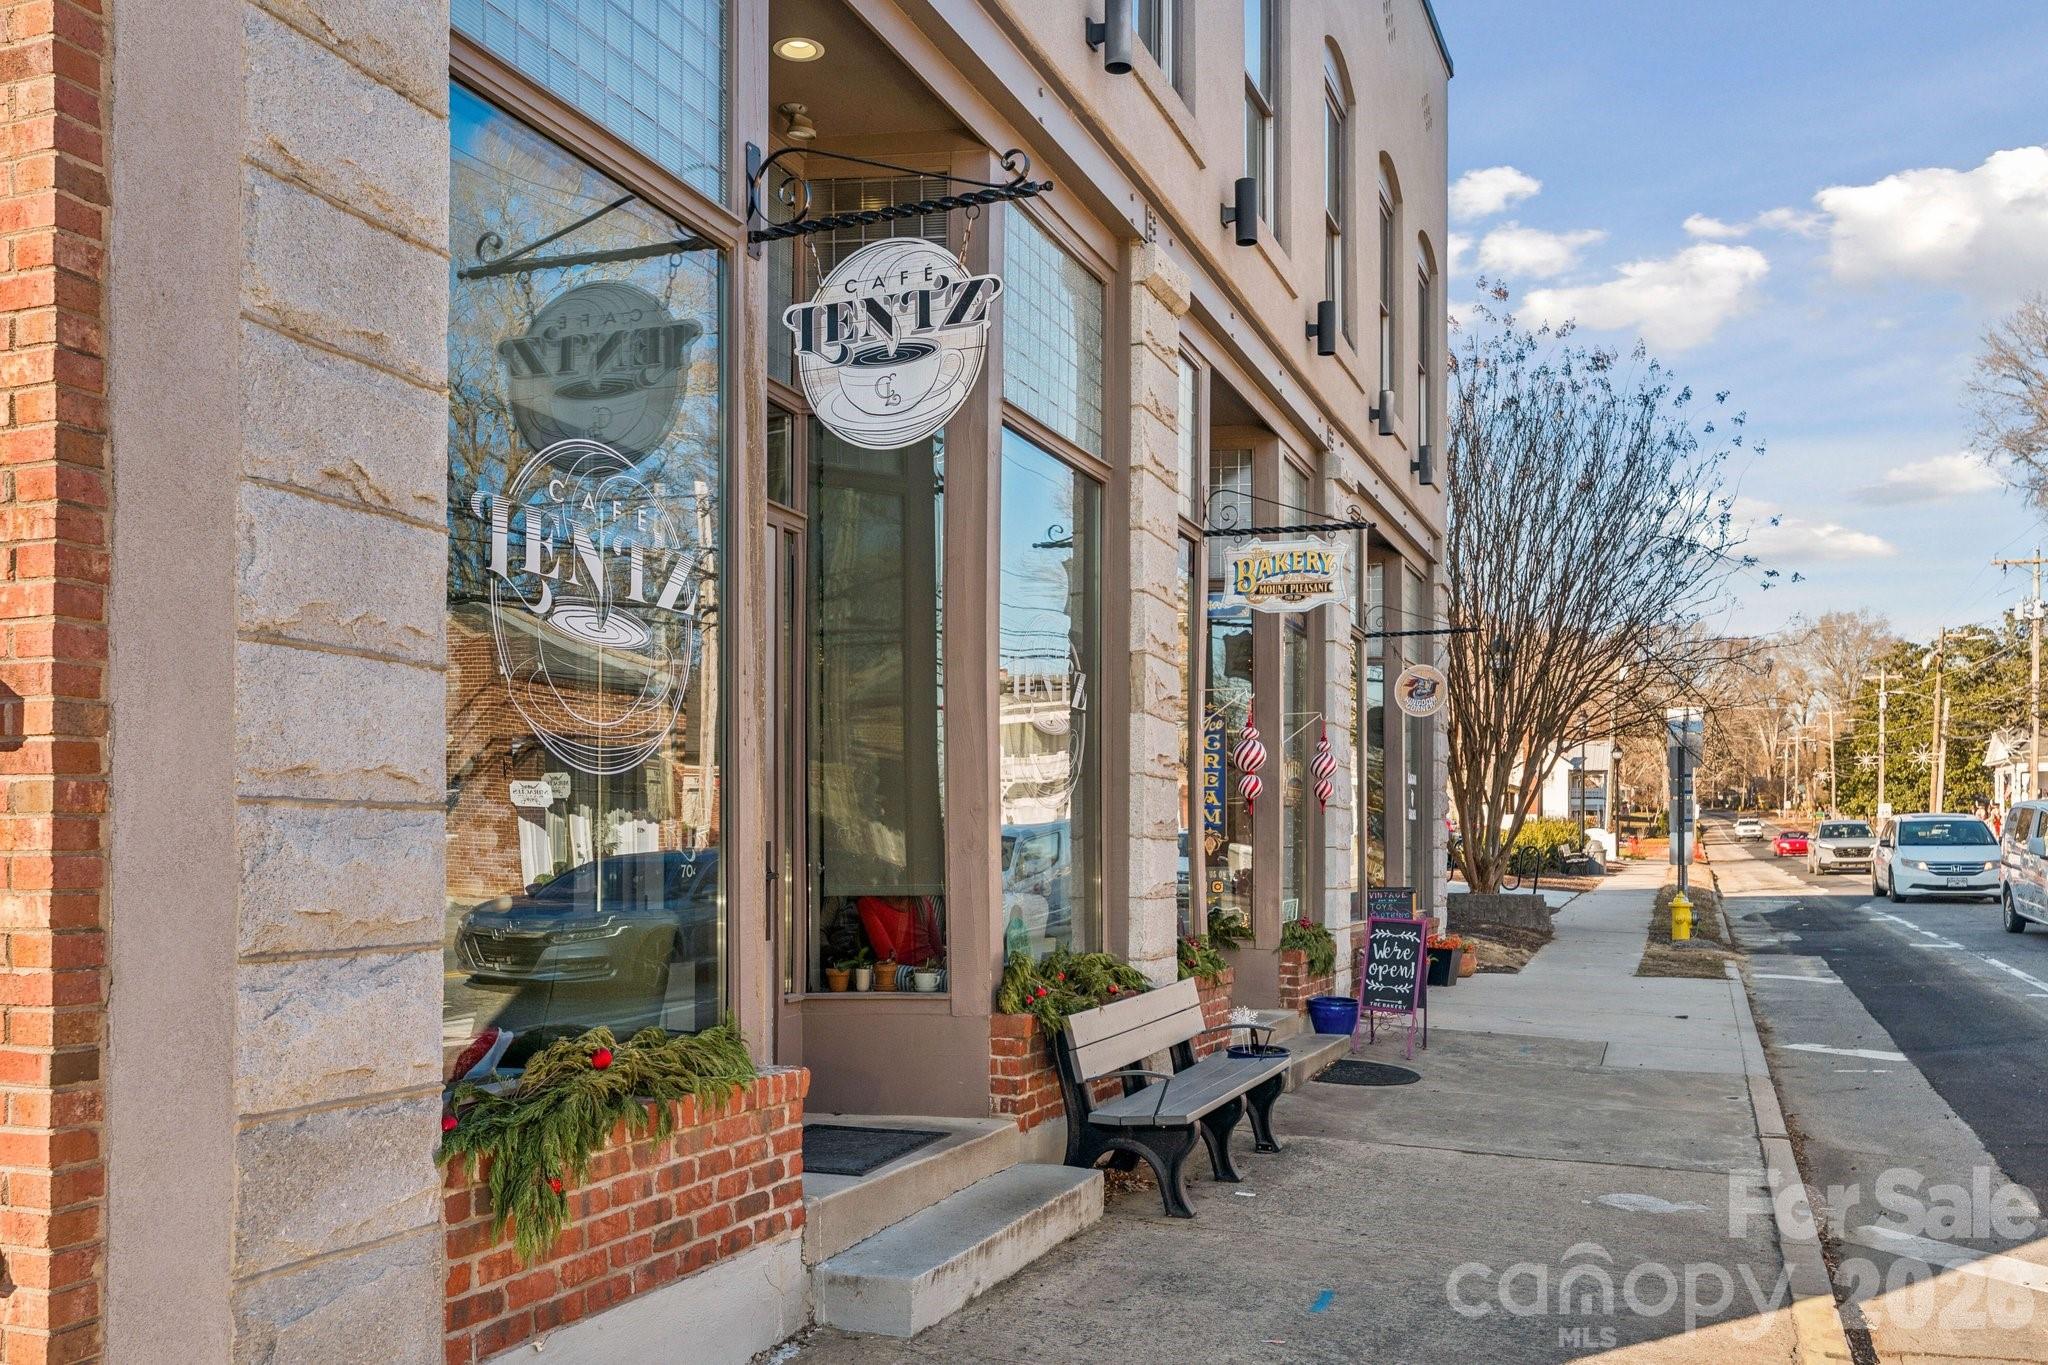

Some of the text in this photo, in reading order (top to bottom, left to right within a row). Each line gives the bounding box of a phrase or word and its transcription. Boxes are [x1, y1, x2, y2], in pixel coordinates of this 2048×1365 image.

[845, 263, 933, 293] CAFÉ
[785, 276, 1002, 365] LENTZ
[470, 489, 699, 616] LENTZ
[1233, 549, 1338, 595] BAKERY
[1259, 582, 1329, 595] MOUNT PLEASANT
[1373, 940, 1415, 961] We're
[1368, 961, 1416, 982] open!
[1382, 1002, 1407, 1010] BAKERY
